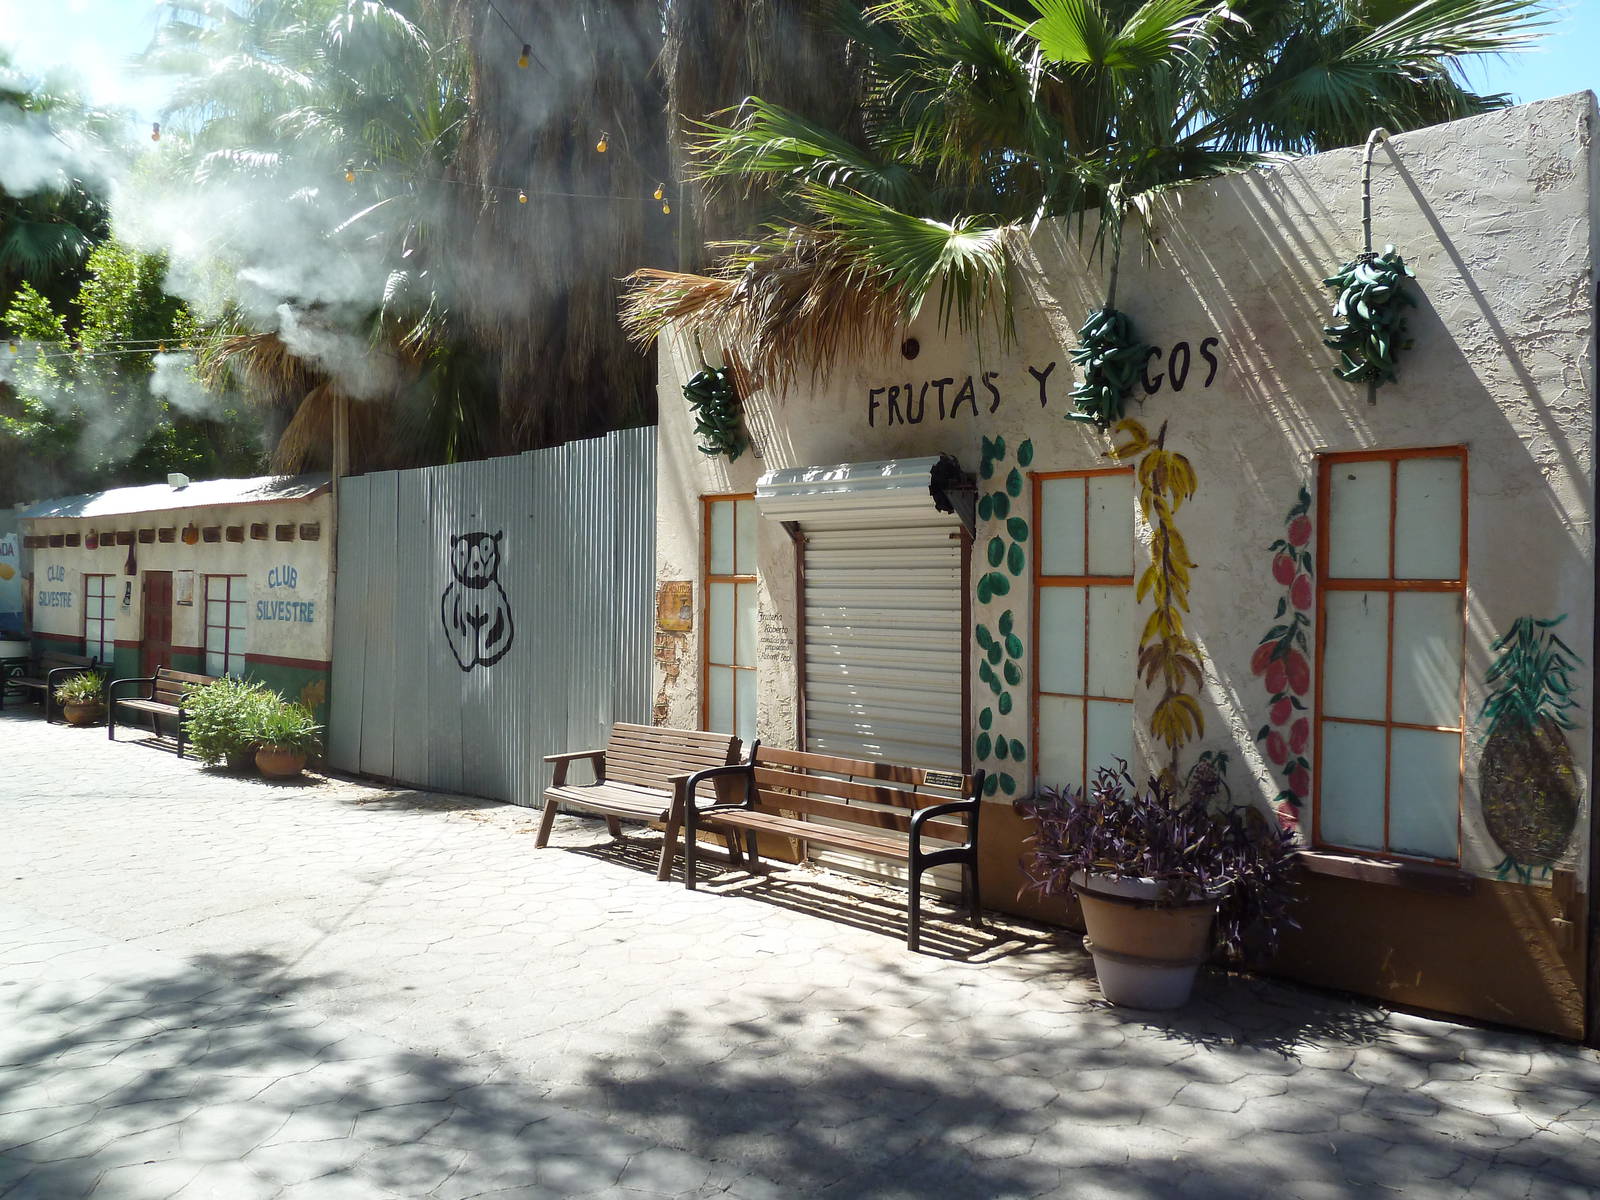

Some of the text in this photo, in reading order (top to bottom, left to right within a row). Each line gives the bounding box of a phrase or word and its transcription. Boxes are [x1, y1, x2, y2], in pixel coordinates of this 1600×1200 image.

[868, 337, 1219, 427] FRUTAS Y GOS
[0, 543, 15, 556] DA
[48, 564, 65, 582] CLUB
[268, 565, 298, 589] CLUB
[38, 591, 72, 608] SILVESTRE
[256, 600, 315, 622] SILVESTRE
